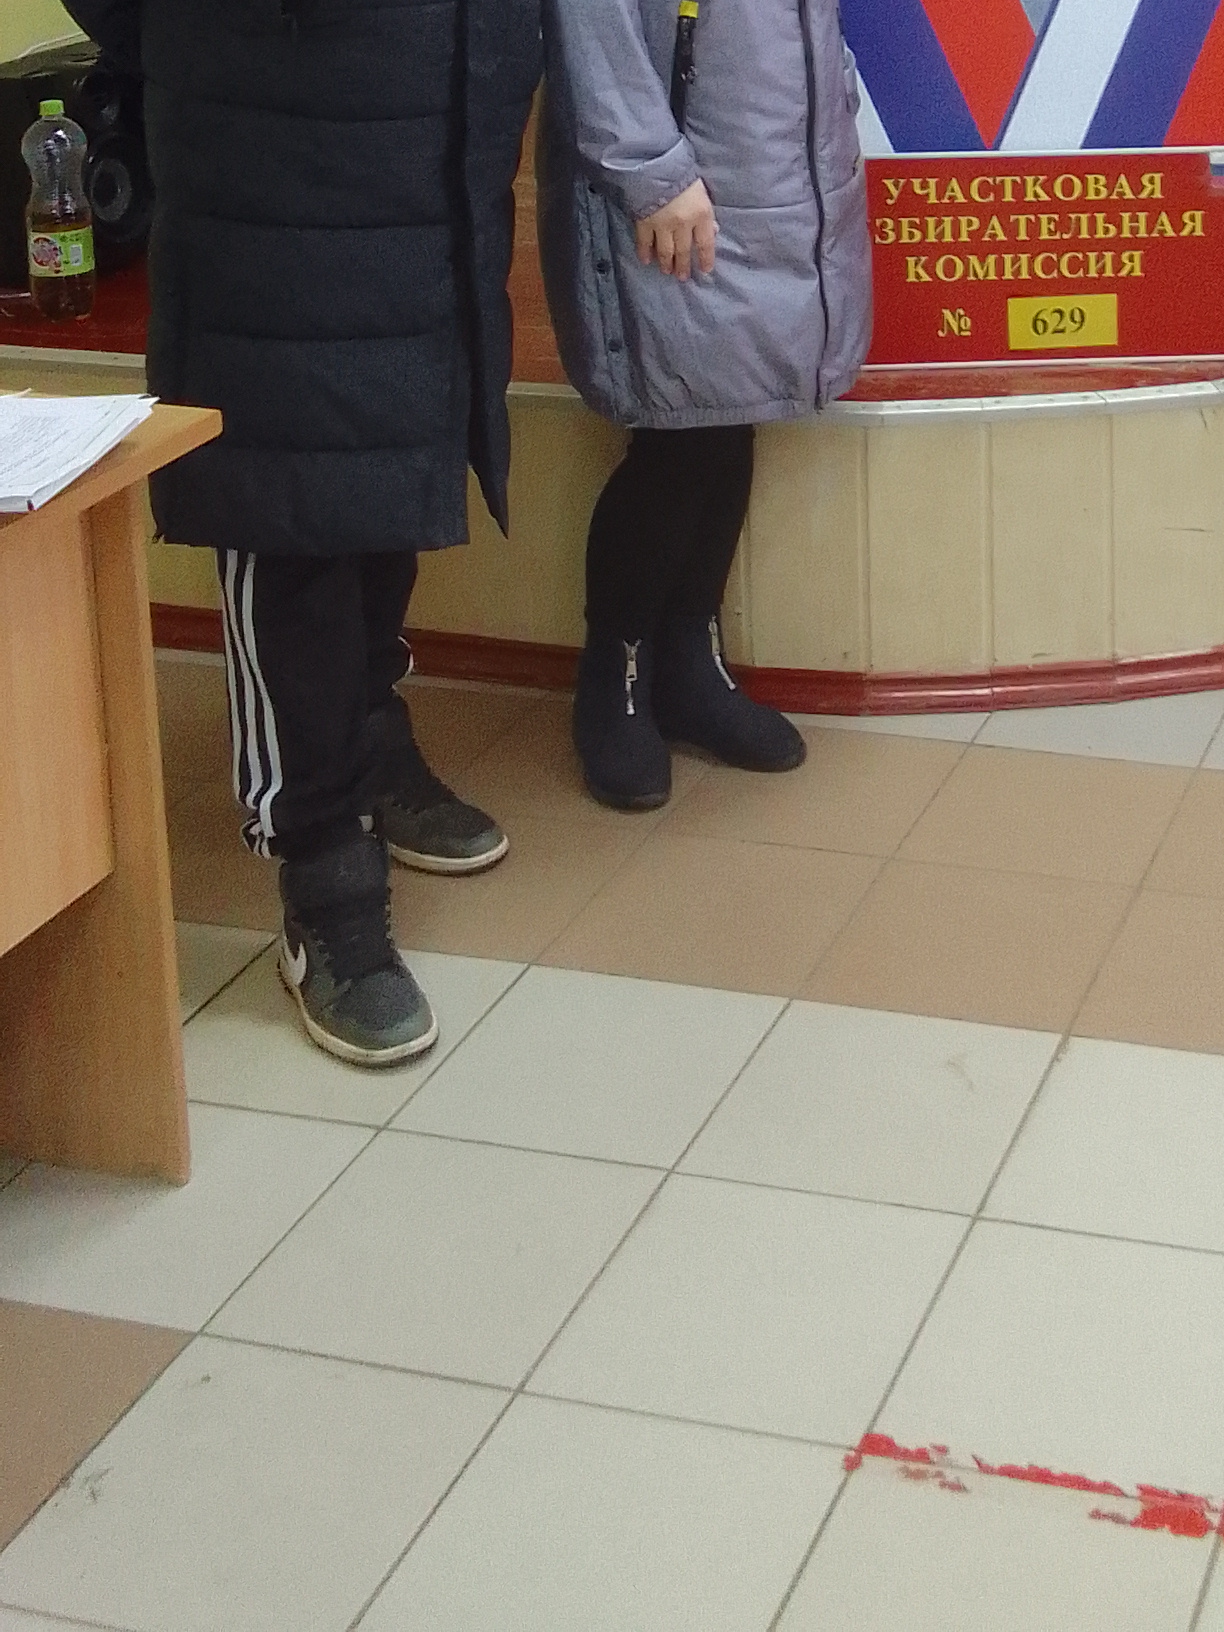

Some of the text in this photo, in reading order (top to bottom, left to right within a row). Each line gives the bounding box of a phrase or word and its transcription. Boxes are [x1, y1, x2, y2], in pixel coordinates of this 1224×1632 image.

[882, 172, 1165, 205] УЧАСТКОВАЯ
[874, 210, 1206, 245] ЗБИРАТЕЛЬНАЯ
[905, 250, 1145, 283] КОМИССИЯ
[937, 306, 1087, 337] № 629
